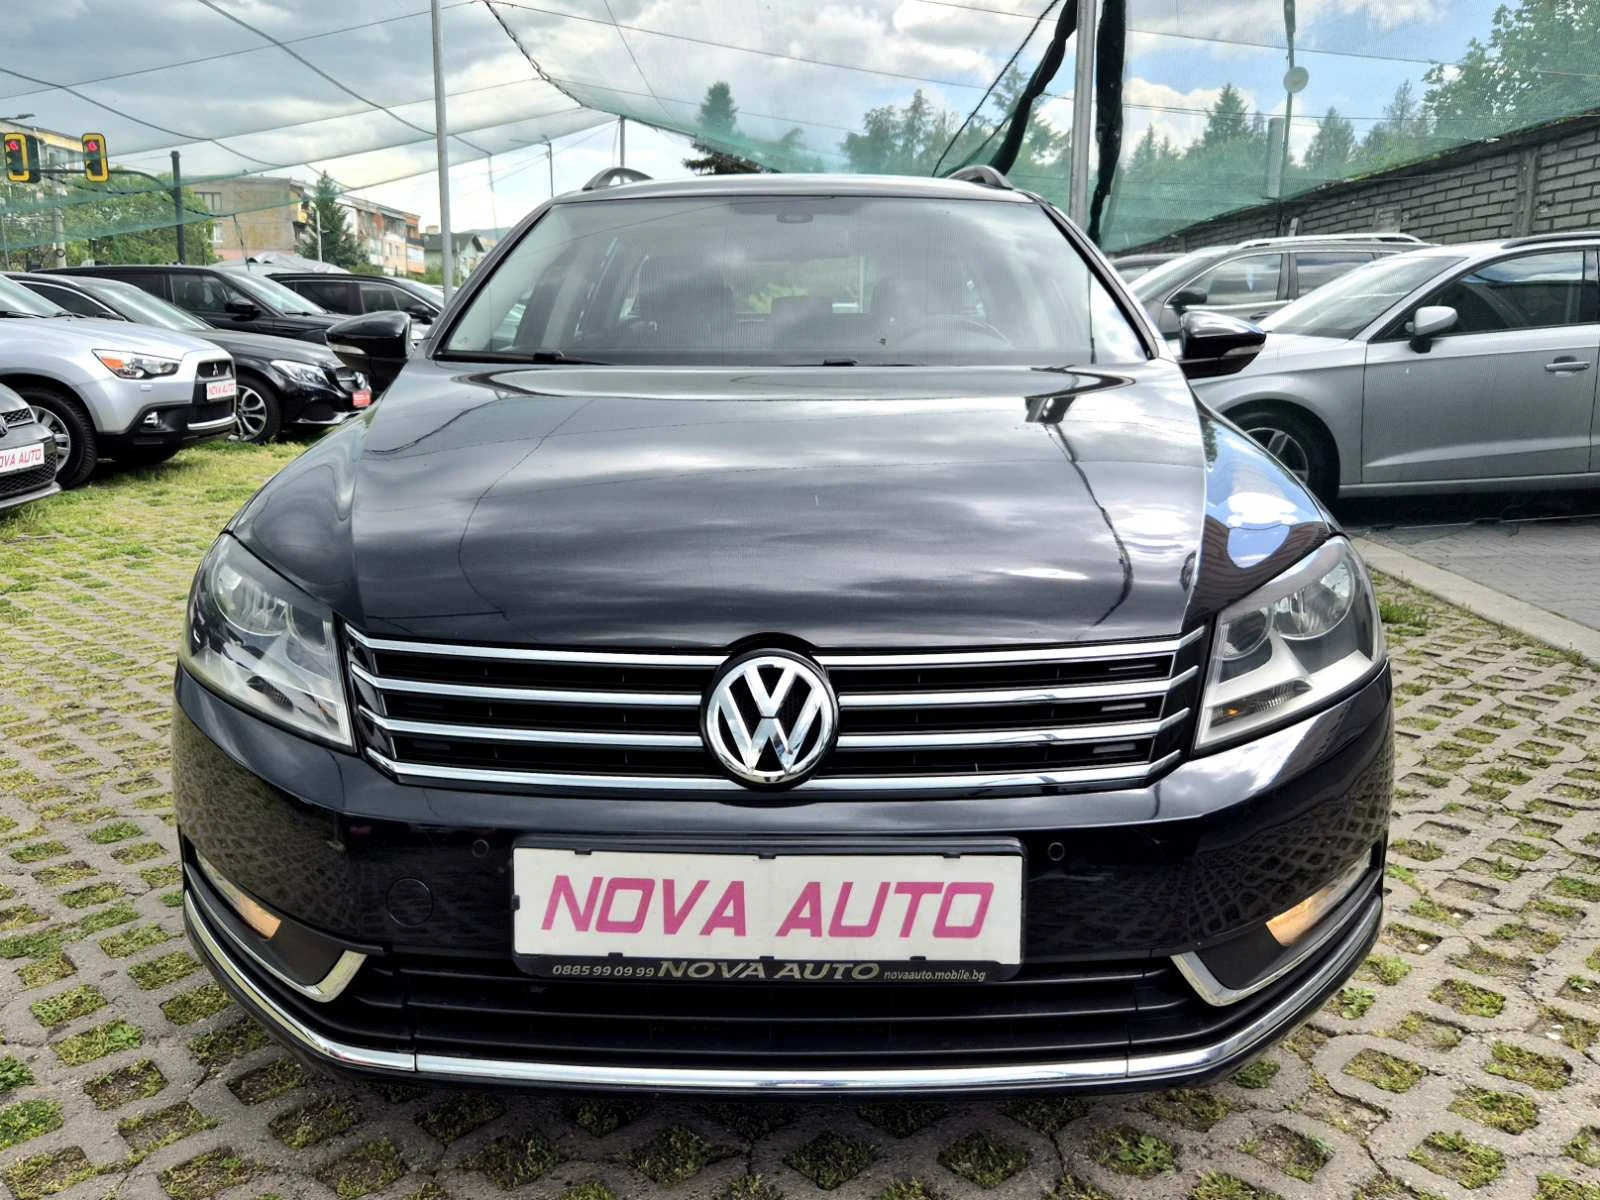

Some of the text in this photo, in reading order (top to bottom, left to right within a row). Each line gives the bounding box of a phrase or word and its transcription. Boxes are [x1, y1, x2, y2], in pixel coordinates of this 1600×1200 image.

[19, 448, 42, 464] AUTO
[541, 875, 994, 938] NOVA AUTO
[552, 960, 986, 982] 0885 99 09 99 NOVA AUTO novaauto.mobile.bg
